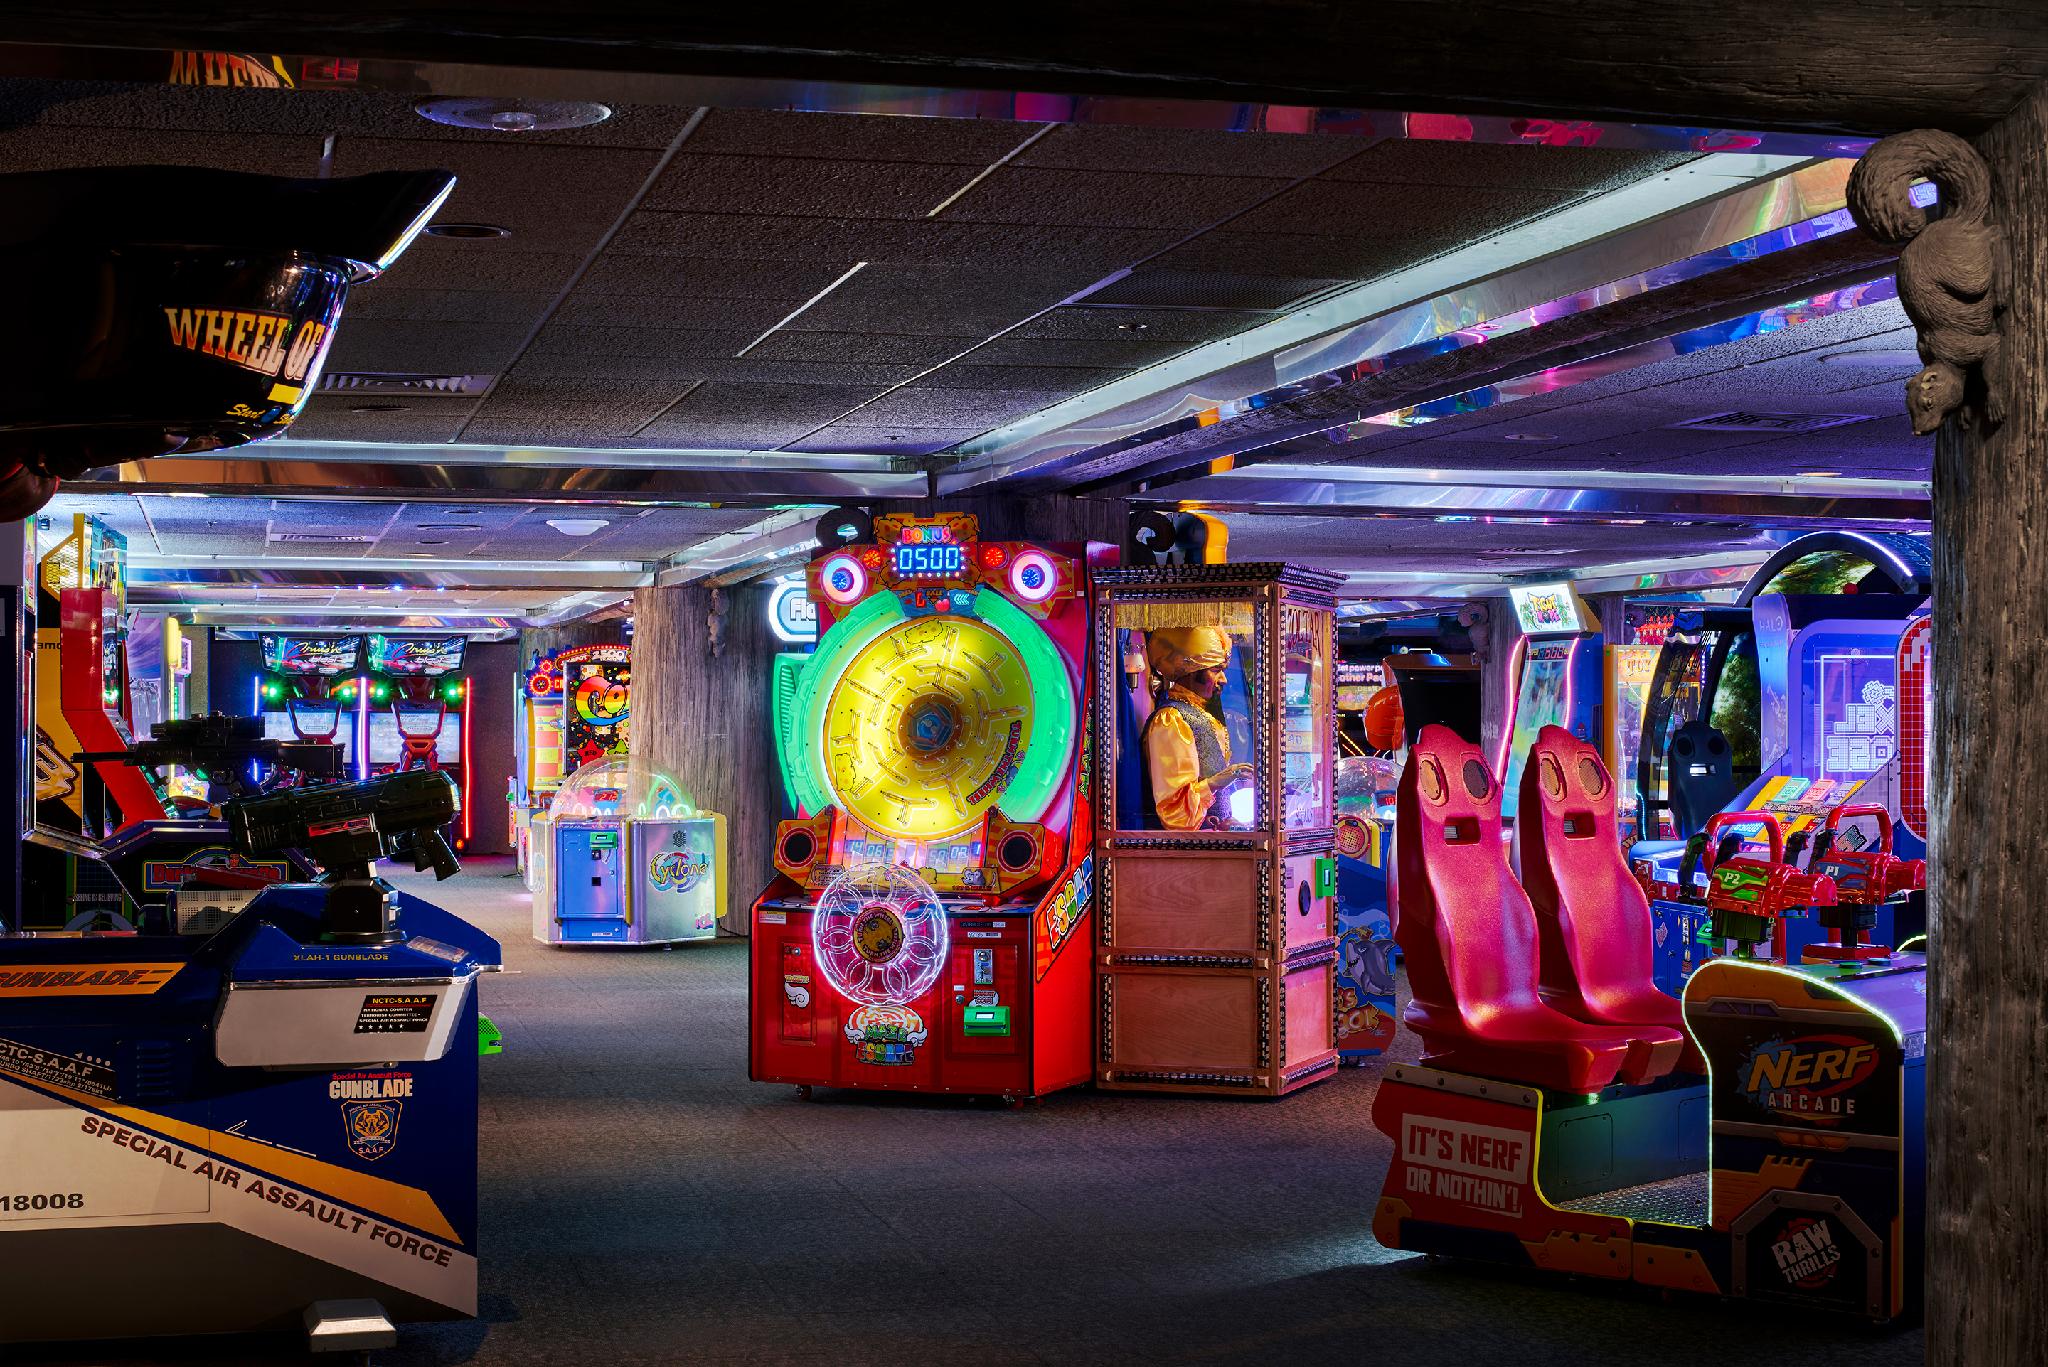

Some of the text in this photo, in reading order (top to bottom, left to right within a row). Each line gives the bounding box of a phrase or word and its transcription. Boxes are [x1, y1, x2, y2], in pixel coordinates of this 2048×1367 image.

[164, 308, 326, 381] WHEEL OF
[902, 527, 951, 544] BONUS
[899, 547, 959, 570] 0500
[651, 854, 709, 885] Cyclone
[1724, 872, 1741, 885] P2
[1825, 865, 1840, 877] P1
[333, 953, 389, 961] GUNBLADE
[0, 1043, 93, 1077] CTC-S.A.A.F
[1746, 1044, 1875, 1093] NERF
[329, 1078, 413, 1099] GUNBLADE
[1768, 1092, 1856, 1114] ARCADE
[1408, 1124, 1523, 1172] IT'S NERF
[81, 1116, 453, 1268] SPECIAL AIR ASSAULT FORCE
[1405, 1166, 1519, 1212] OR NOTHIN'!
[1771, 1220, 1832, 1269] RAW
[1782, 1244, 1841, 1283] THRILLS
